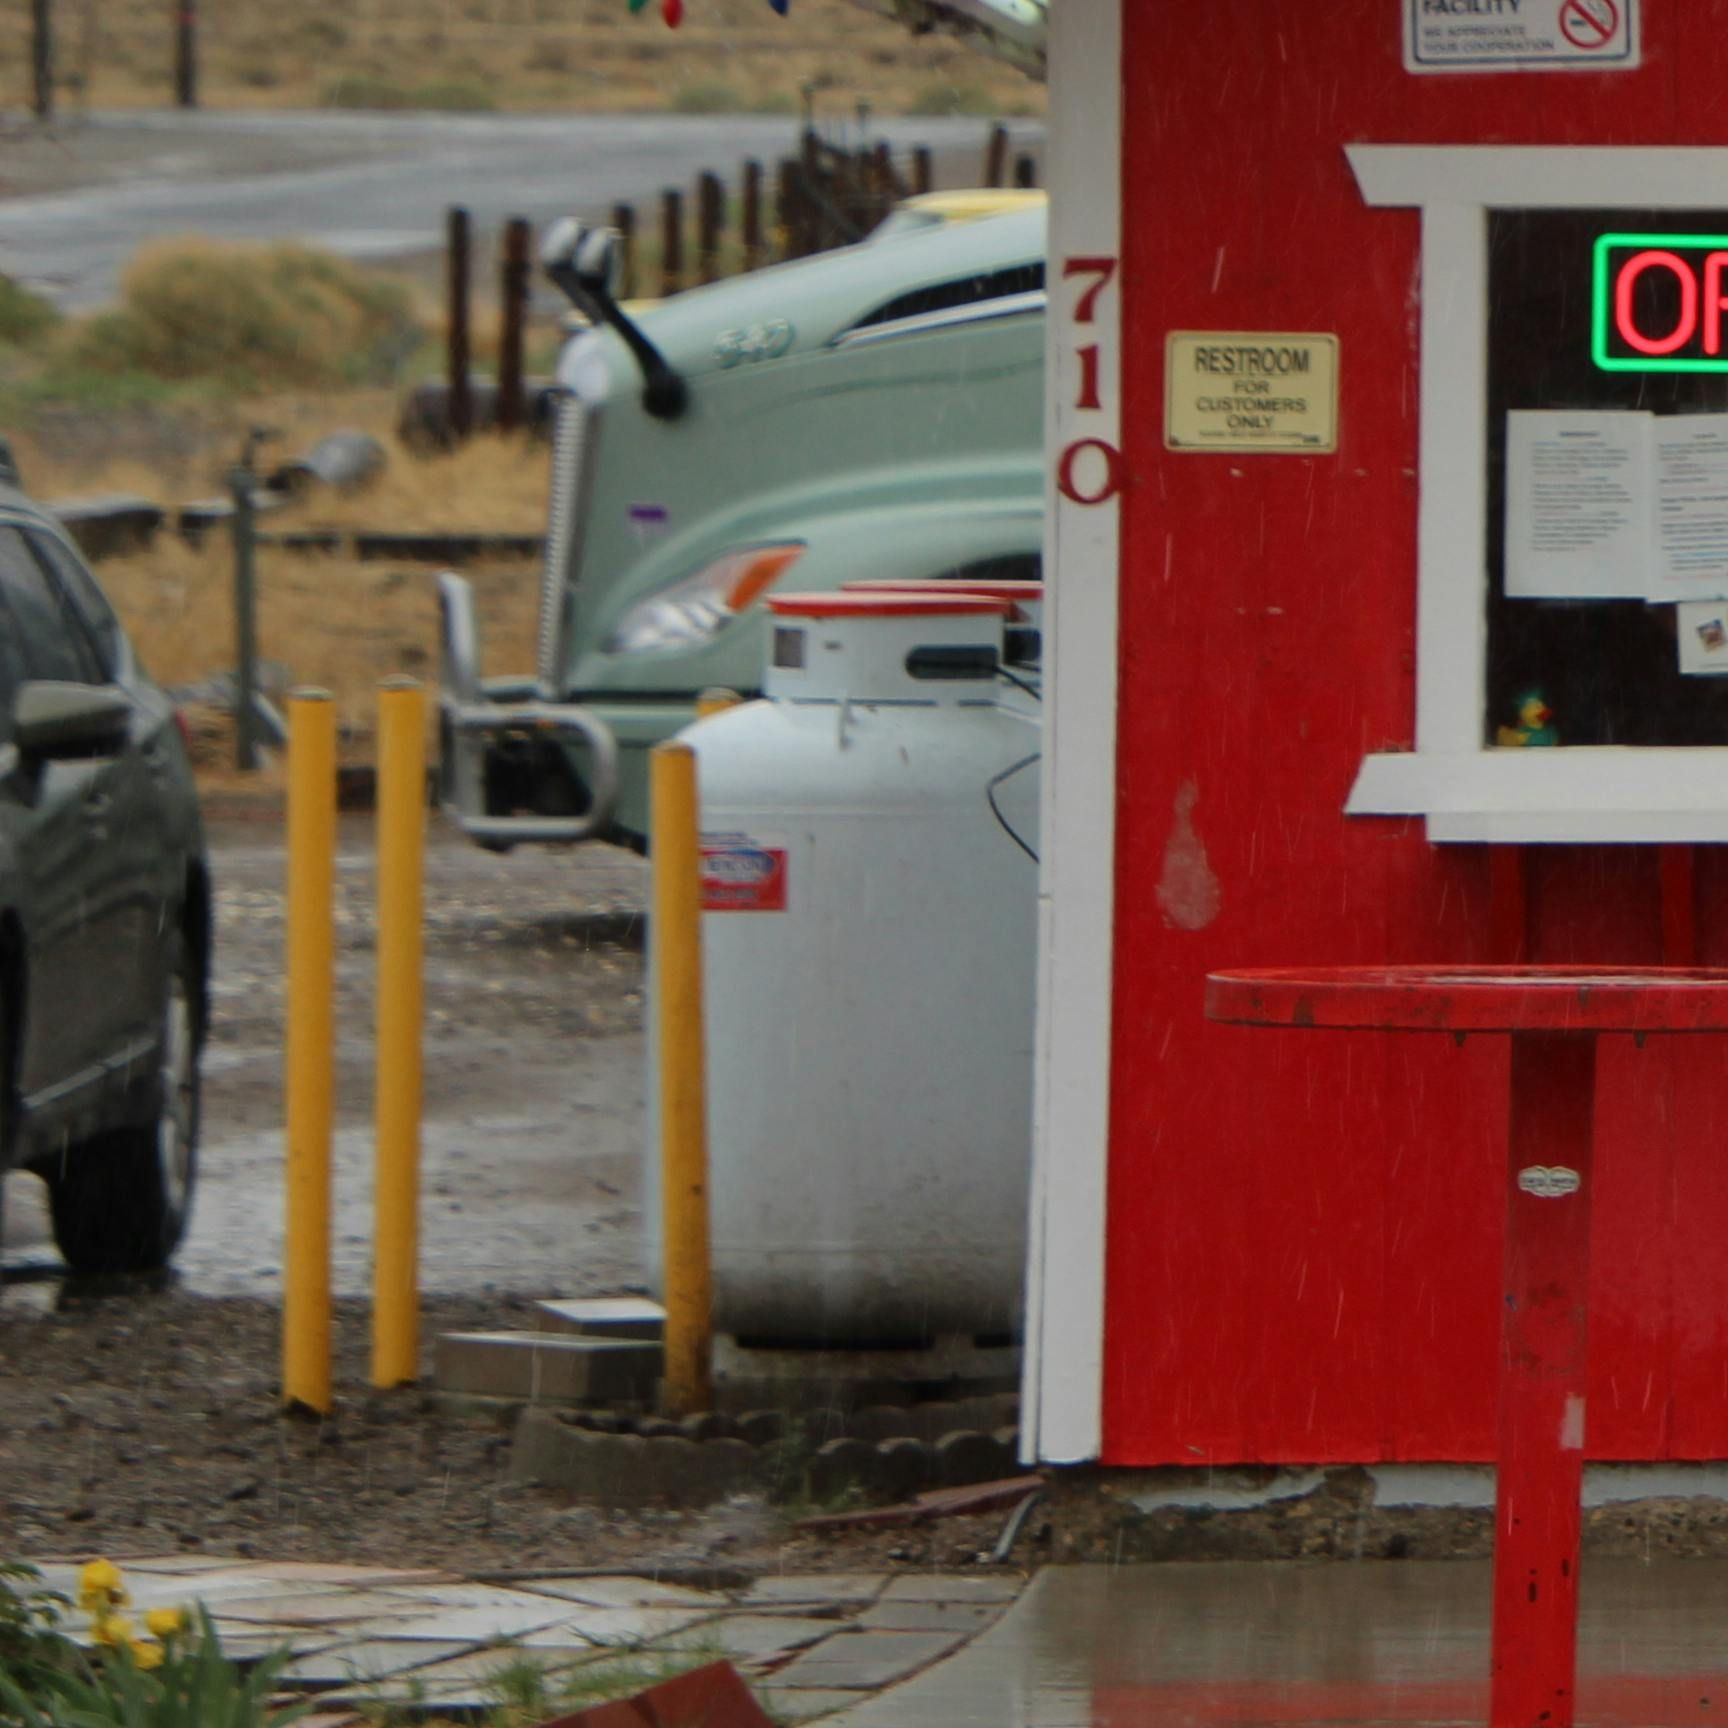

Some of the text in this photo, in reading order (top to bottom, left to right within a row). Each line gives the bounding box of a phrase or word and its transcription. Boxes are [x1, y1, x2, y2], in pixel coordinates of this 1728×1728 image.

[1195, 347, 1310, 372] RESTROOM
[1234, 380, 1269, 394] FOR
[1196, 398, 1307, 413] CUSTOMERS
[1227, 416, 1274, 430] ONLY
